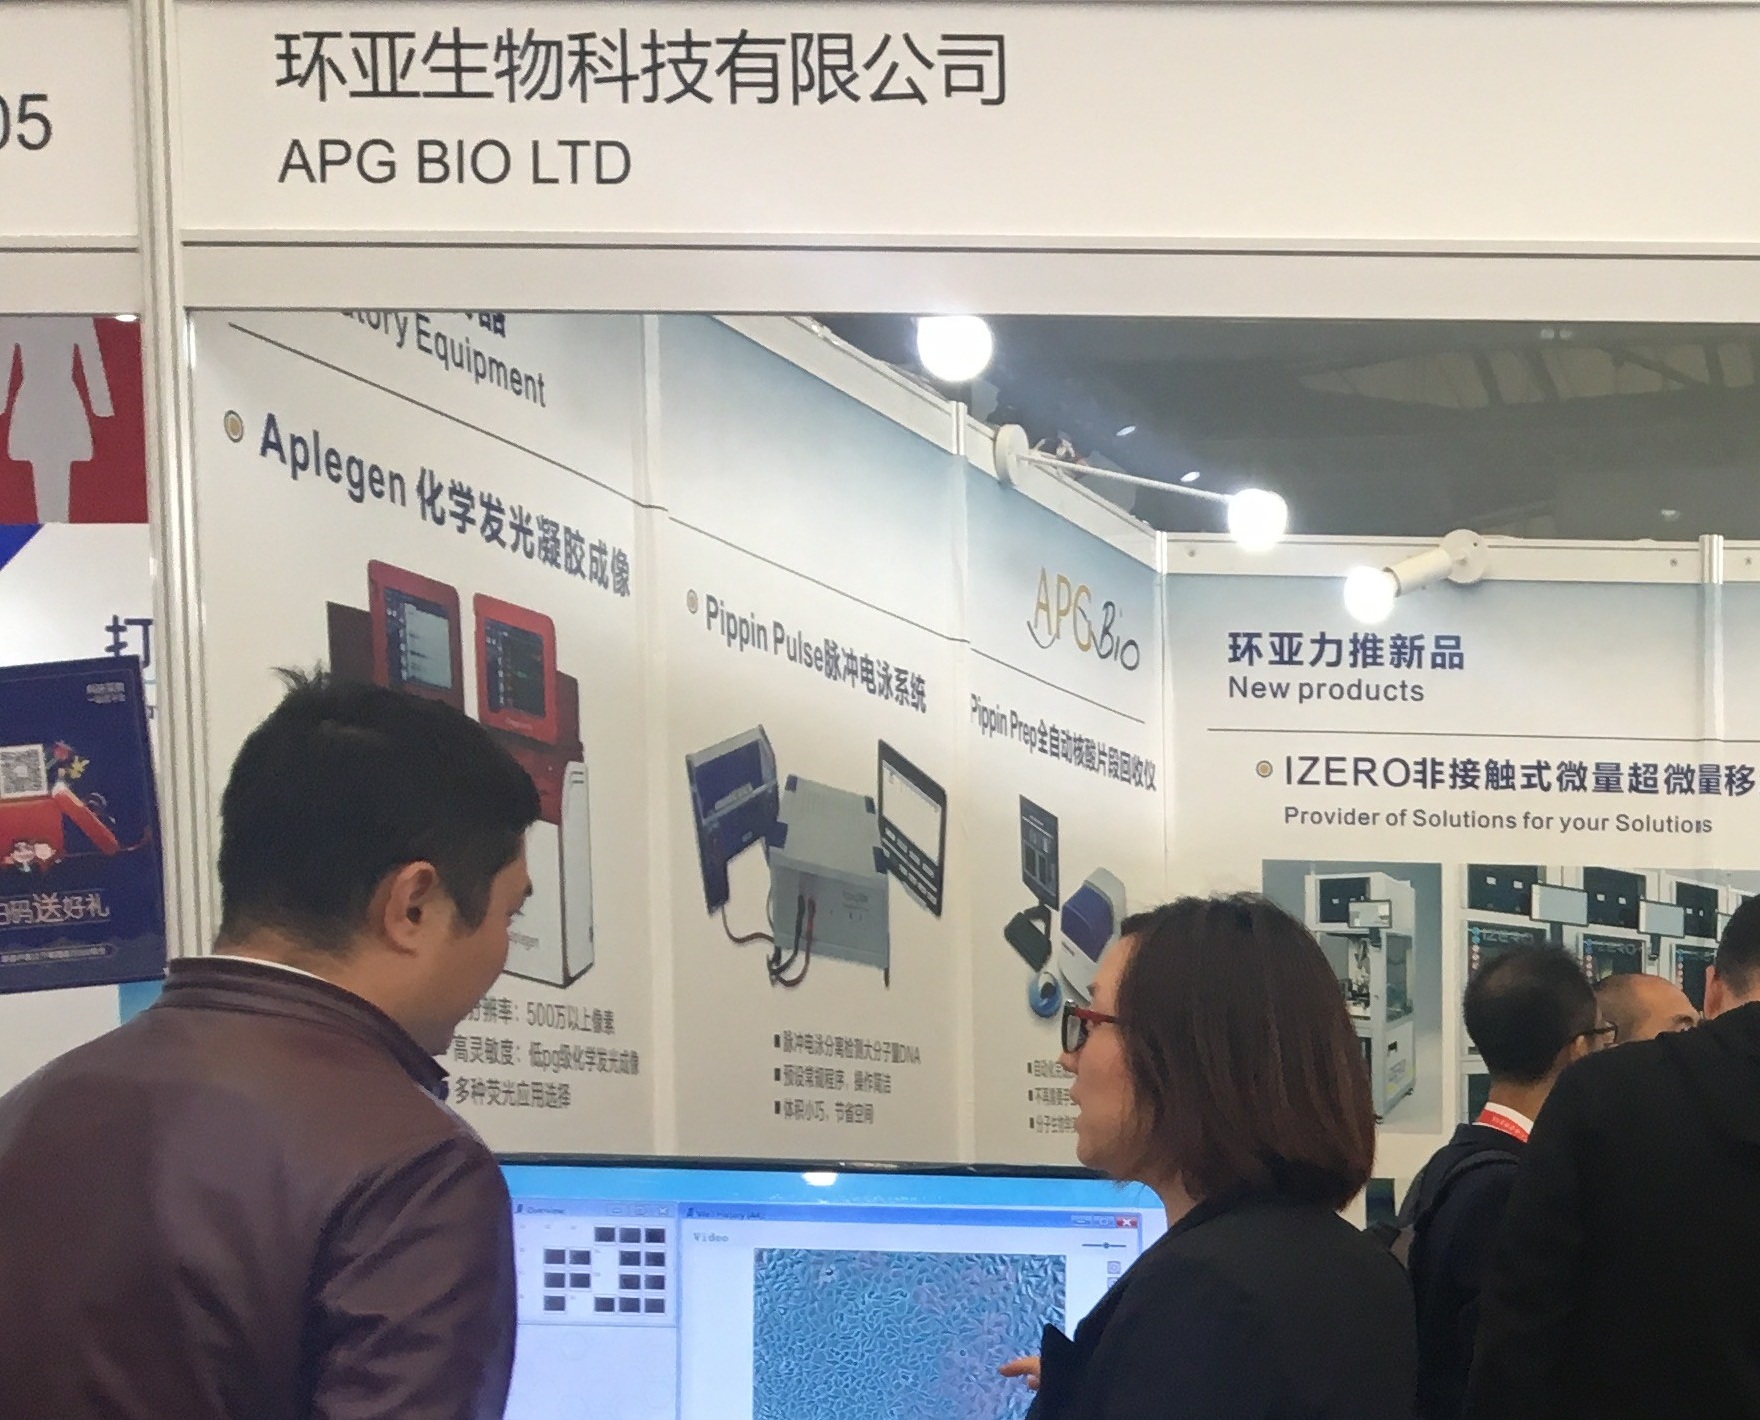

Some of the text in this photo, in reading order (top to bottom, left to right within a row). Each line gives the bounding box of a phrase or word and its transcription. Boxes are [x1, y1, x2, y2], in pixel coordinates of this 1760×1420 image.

[274, 30, 1006, 107] 环亚生物科技有限公司
[278, 138, 633, 186] APG BIO LTD
[416, 312, 547, 408] Equipment
[259, 412, 631, 597] Aplegen 化学发光凝胶成像
[705, 594, 927, 713] Pippin Pulse脉冲电泳系统
[1228, 631, 1465, 670] 环亚力推新品
[1228, 675, 1425, 704] New products
[970, 693, 1007, 739] Pippin
[1285, 806, 1380, 826] Provider
[1386, 808, 1408, 827] of
[1412, 808, 1518, 830] Solutions
[1523, 811, 1554, 830] for
[1559, 814, 1609, 833] your
[693, 1231, 729, 1243] Video
